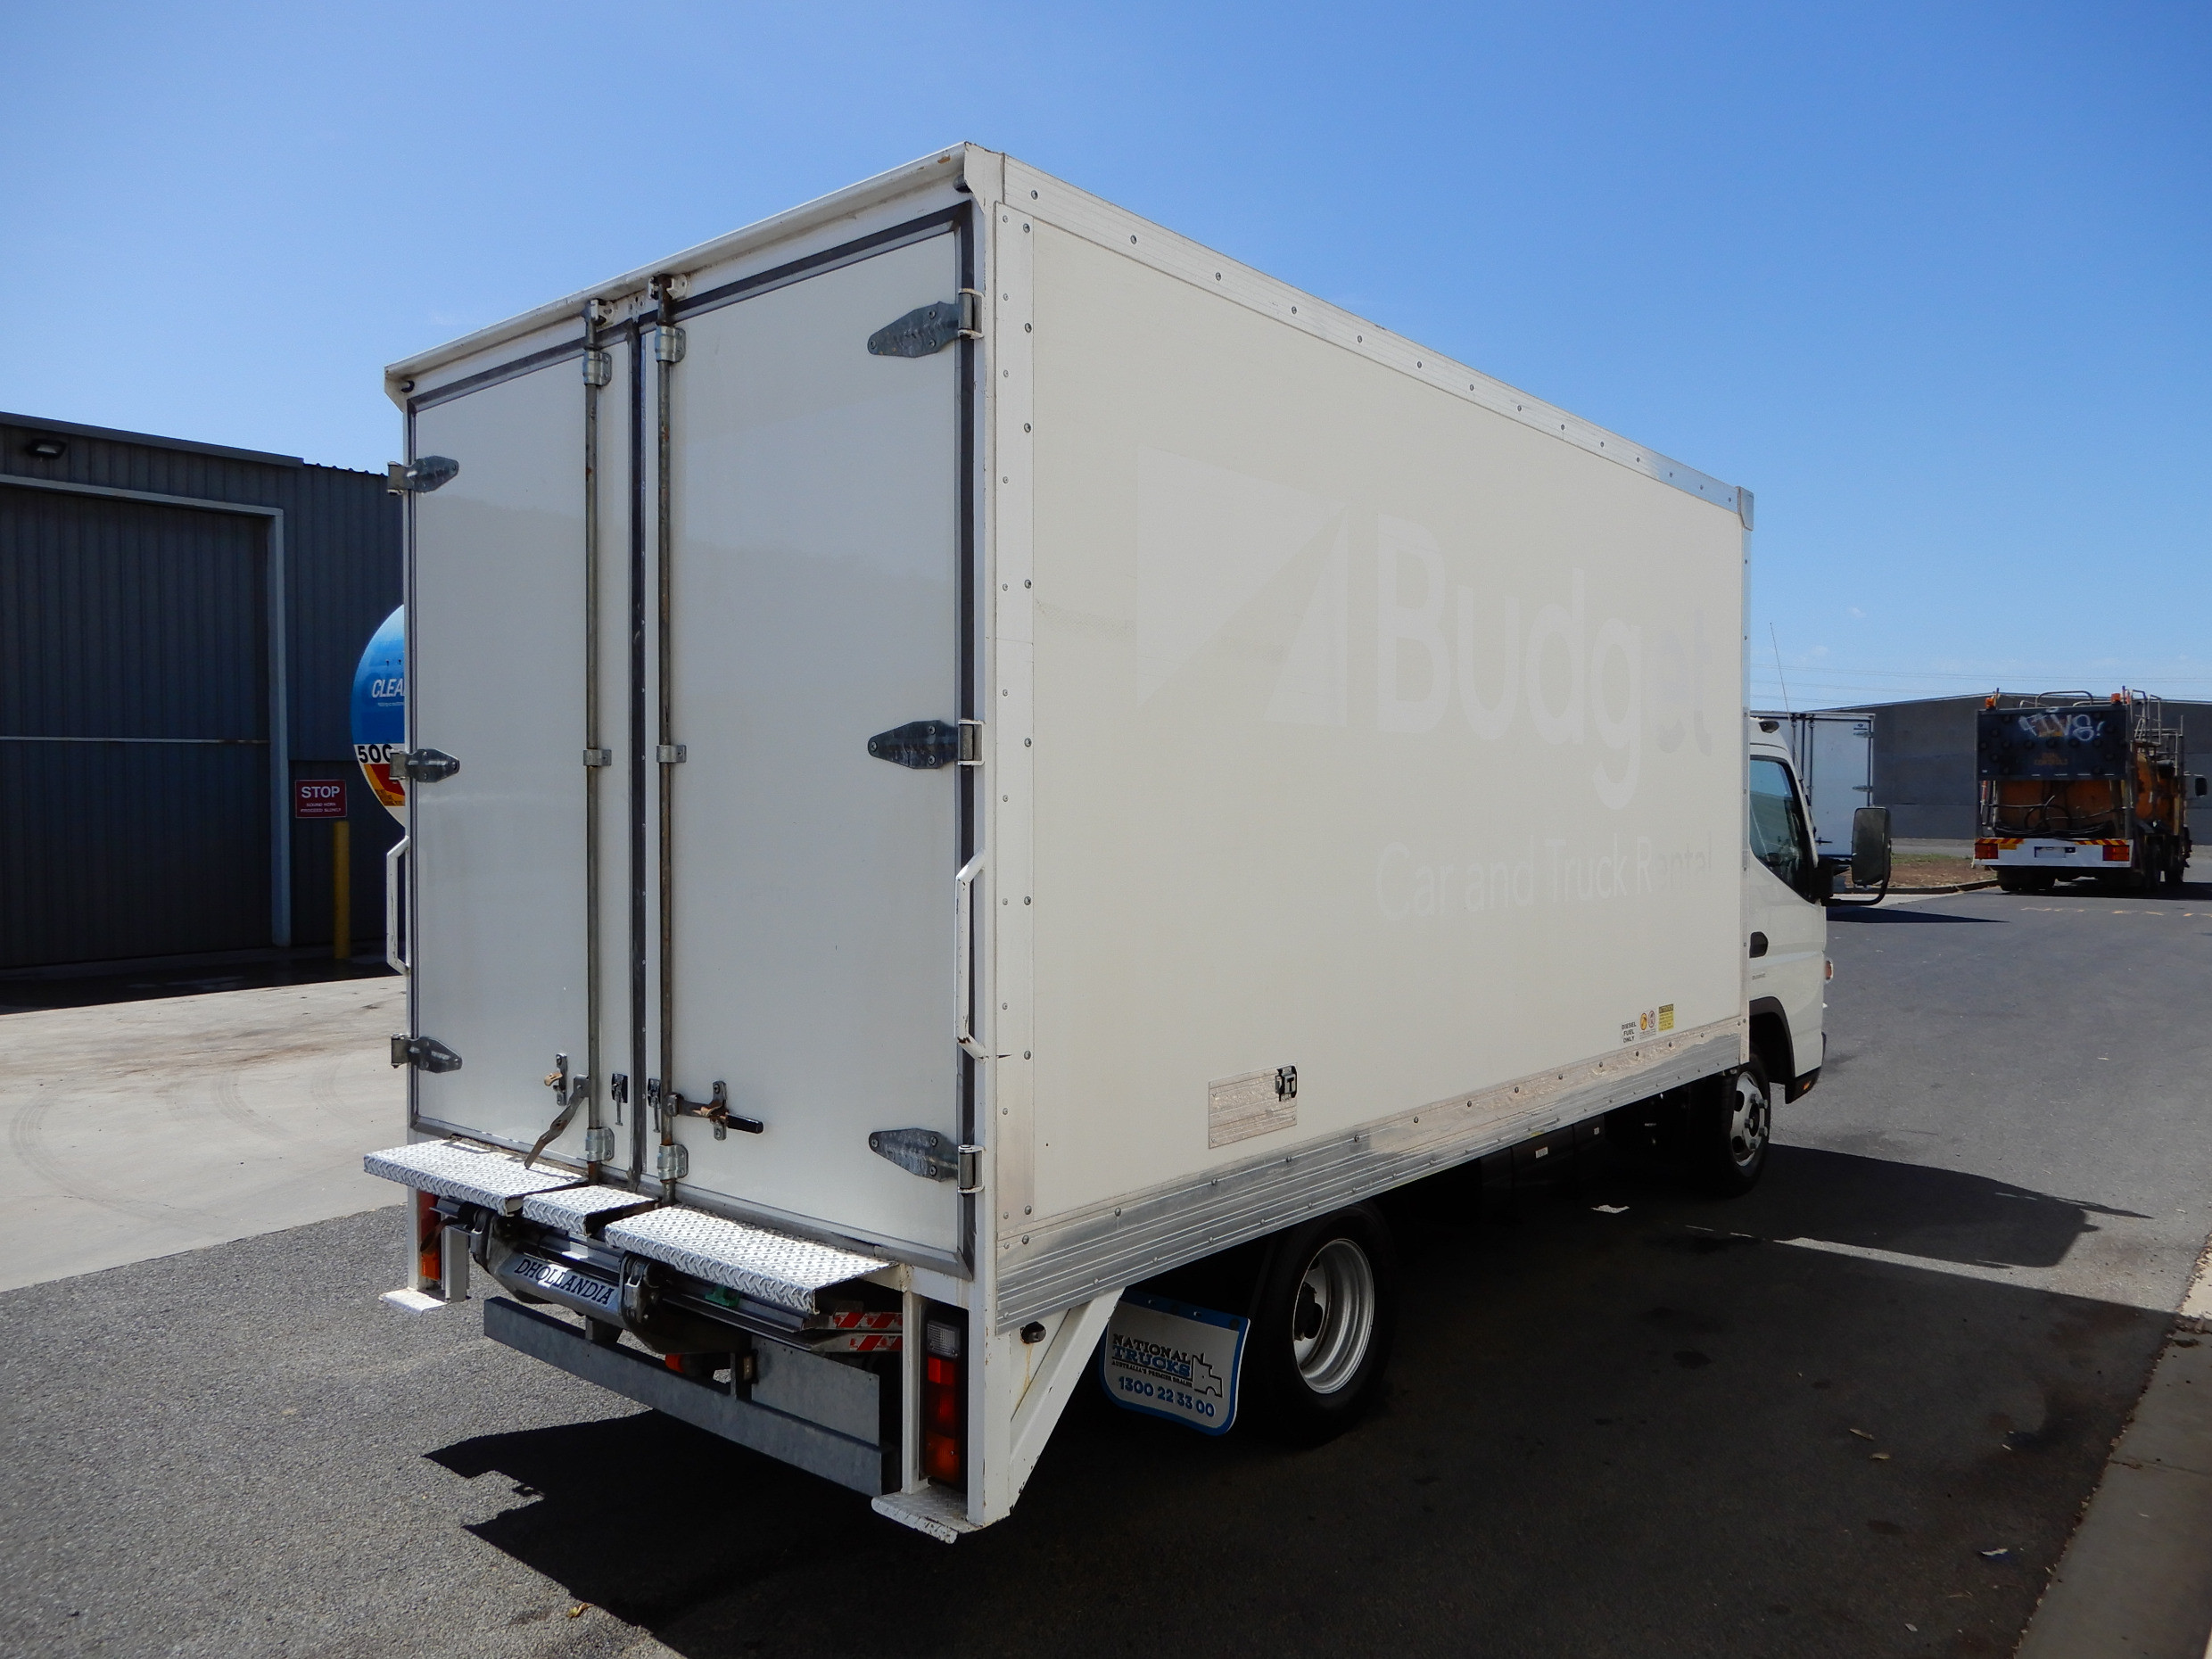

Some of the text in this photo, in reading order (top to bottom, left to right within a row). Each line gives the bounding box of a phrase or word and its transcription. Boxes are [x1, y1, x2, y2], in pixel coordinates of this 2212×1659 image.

[1377, 513, 1713, 810] Budget
[372, 678, 405, 698] CLEA
[301, 786, 341, 798] STOP
[1375, 831, 1713, 921] Car and Truck Rental
[1622, 1021, 1637, 1030] DIESEL
[1622, 1036, 1635, 1044] ONLY
[1623, 1028, 1635, 1036] FUEL
[514, 1259, 615, 1305] DHOLLANDIA
[1112, 1333, 1191, 1365] NATIONAL
[1112, 1344, 1191, 1377] TRUCKS
[1118, 1376, 1216, 1417] 1300 22 33 00
